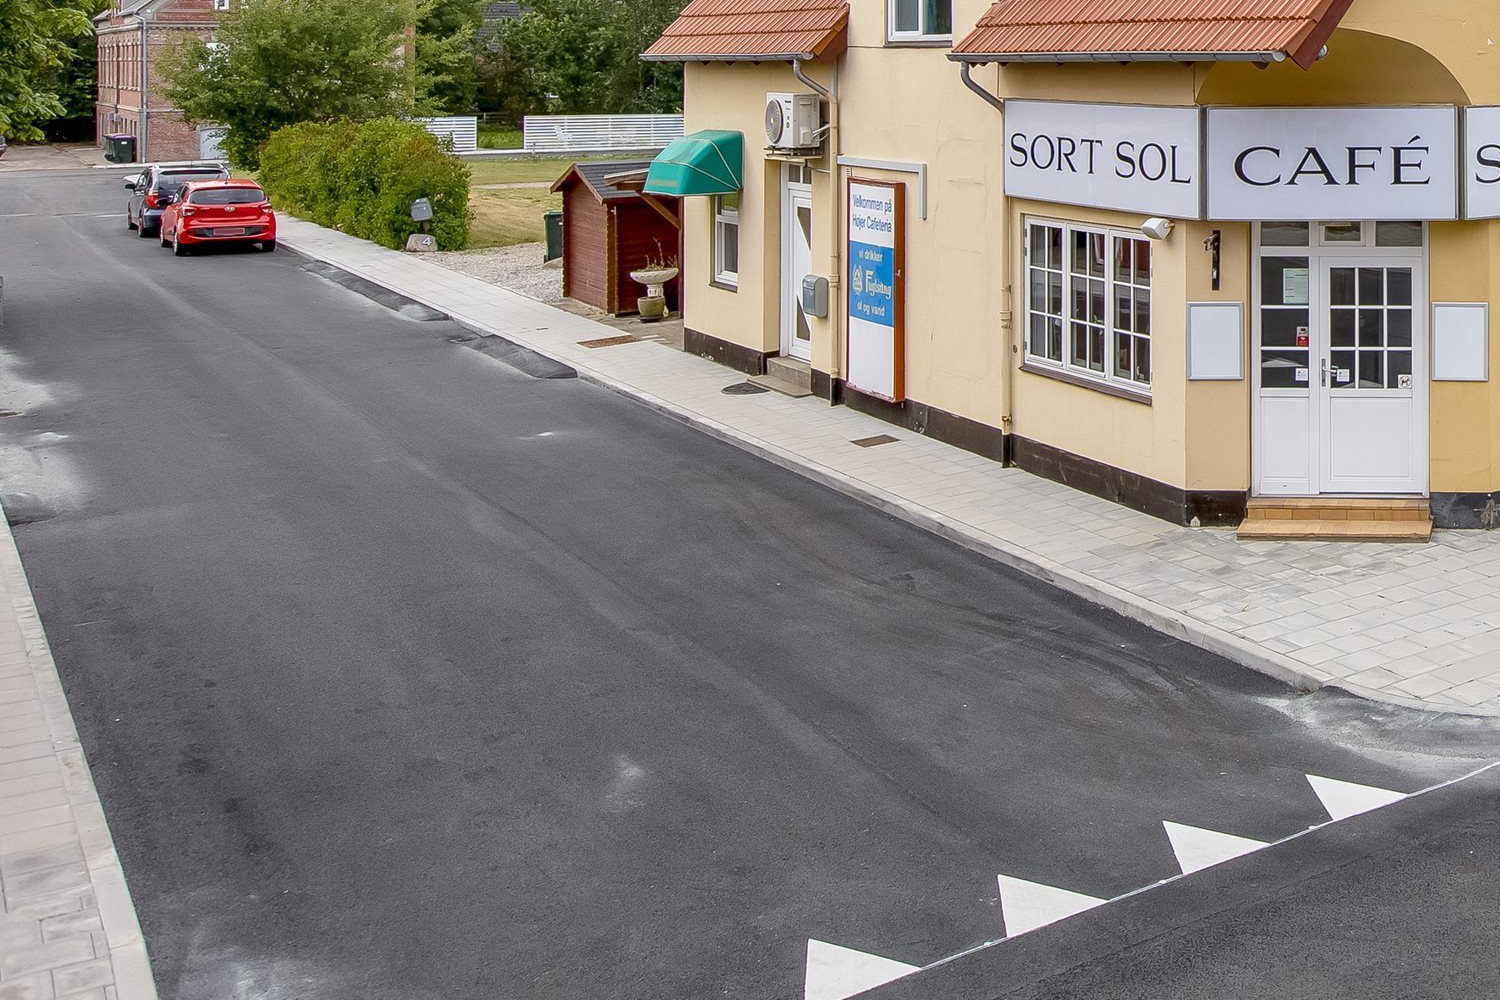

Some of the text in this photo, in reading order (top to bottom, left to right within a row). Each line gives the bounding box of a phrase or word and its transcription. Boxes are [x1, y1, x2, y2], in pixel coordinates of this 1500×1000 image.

[1009, 131, 1192, 184] SORT SOL
[1233, 134, 1432, 186] CAFÉ
[853, 194, 893, 215] Velkommen på
[867, 215, 892, 232] Cafeteria
[422, 236, 432, 246] 4
